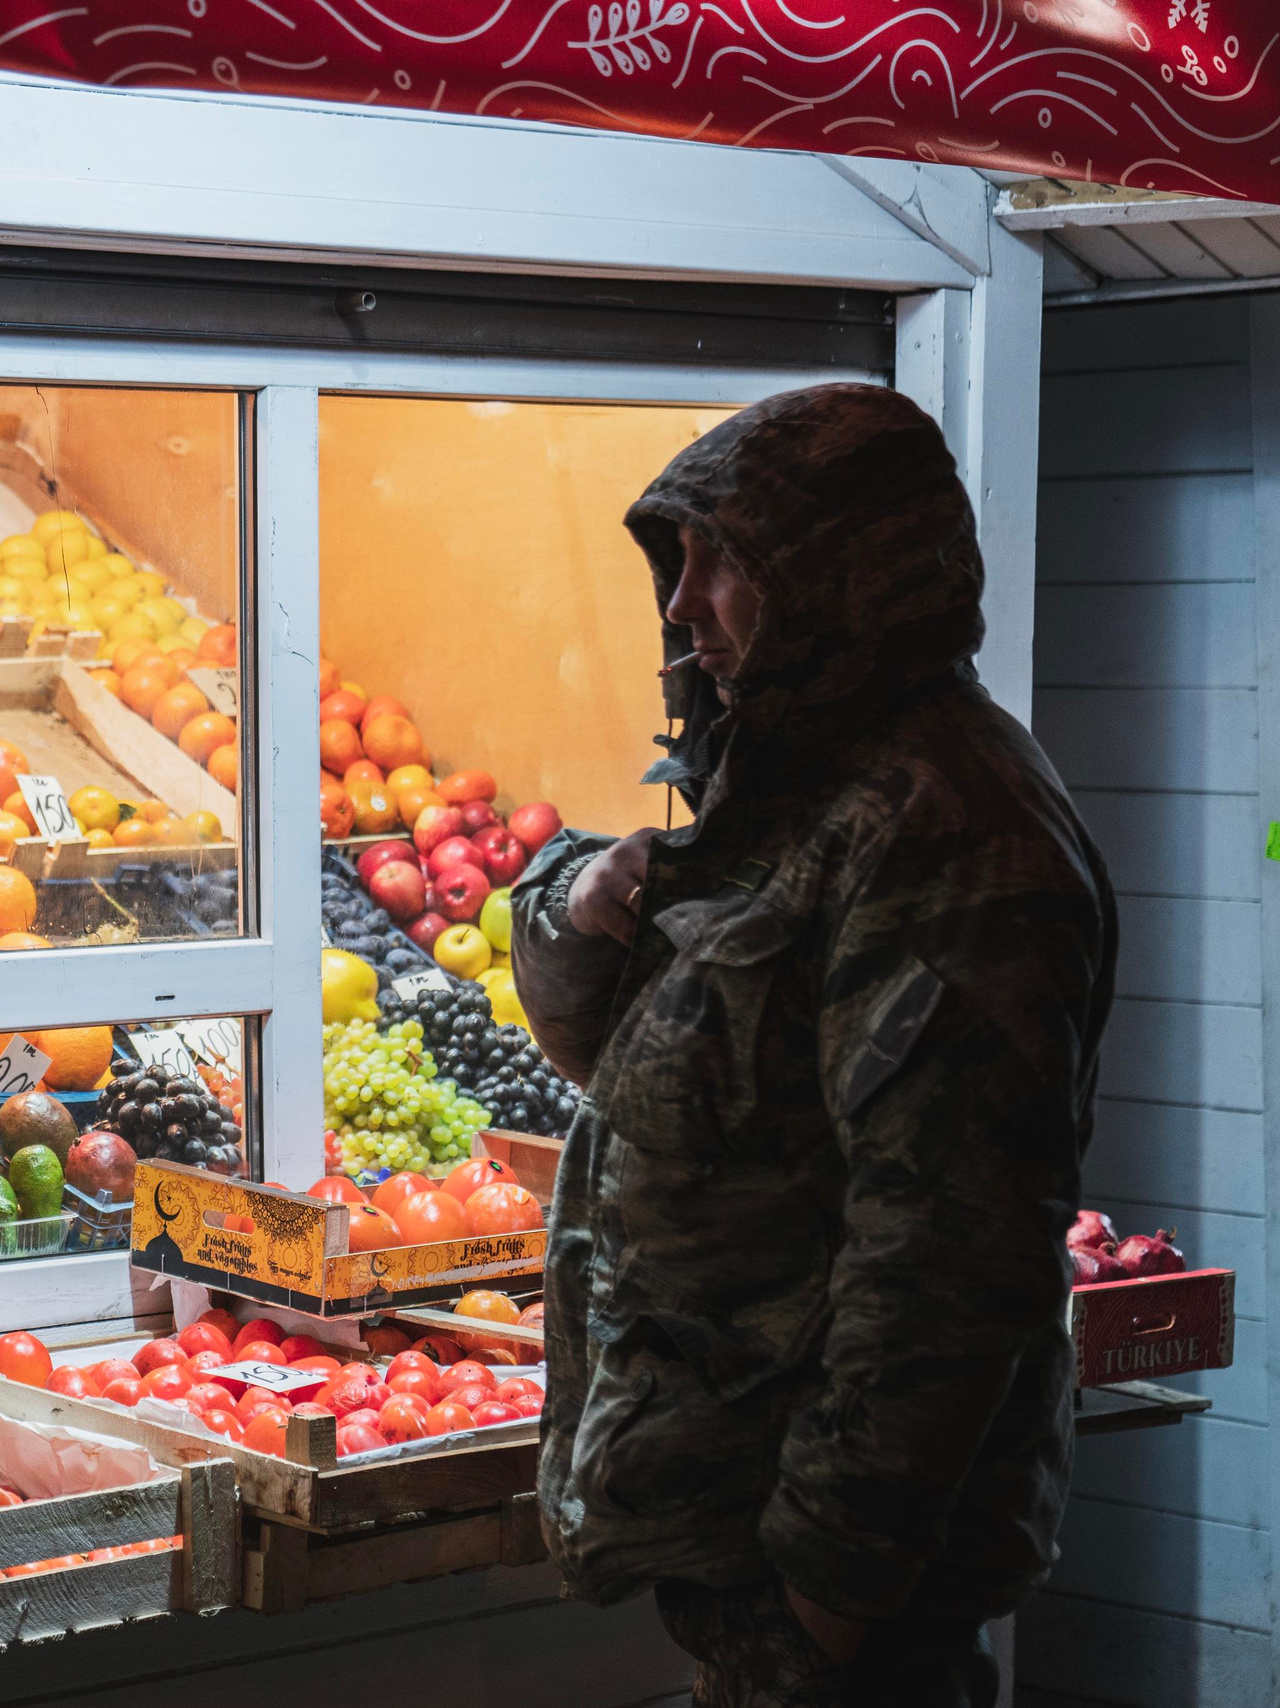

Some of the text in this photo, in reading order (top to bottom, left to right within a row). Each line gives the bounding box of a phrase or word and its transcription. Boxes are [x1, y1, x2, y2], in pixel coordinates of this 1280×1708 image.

[34, 793, 76, 837] 150
[201, 1232, 253, 1259] Fresh fruits
[459, 1237, 526, 1262] Fresh fruits
[196, 1248, 215, 1264] and
[214, 1249, 259, 1275] vegetables
